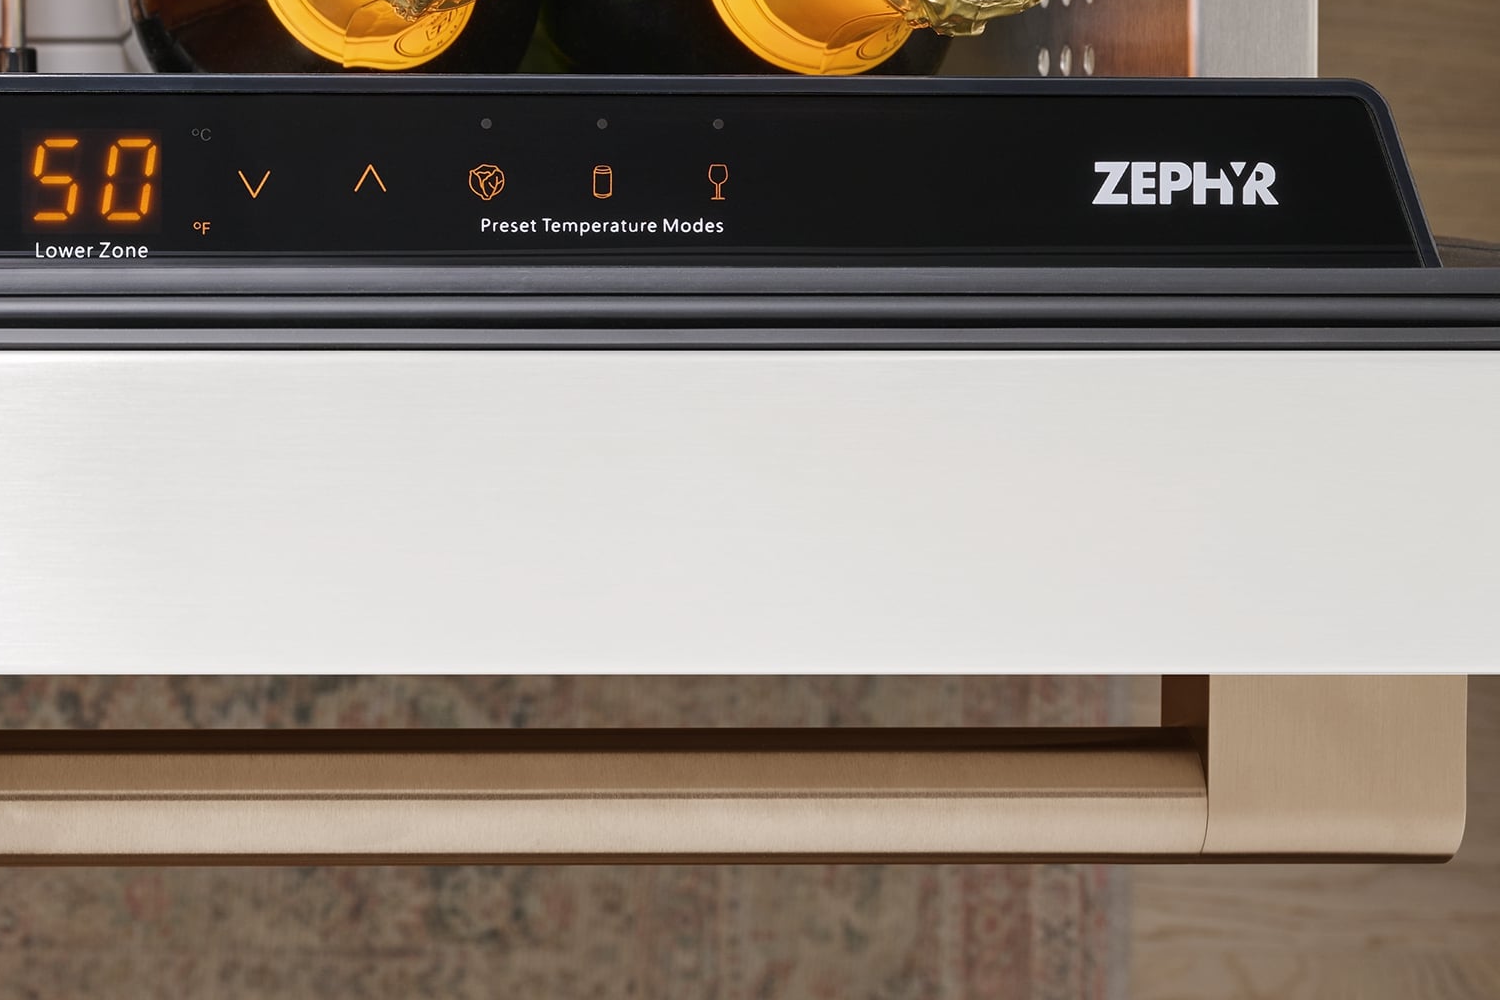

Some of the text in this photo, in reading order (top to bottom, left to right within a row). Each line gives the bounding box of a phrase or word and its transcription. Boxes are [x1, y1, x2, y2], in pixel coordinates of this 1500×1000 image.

[32, 138, 157, 222] 50
[1091, 161, 1280, 206] ZEPHYR
[480, 217, 725, 237] Preset Temperature Modes
[35, 241, 149, 259] Lower Zone
